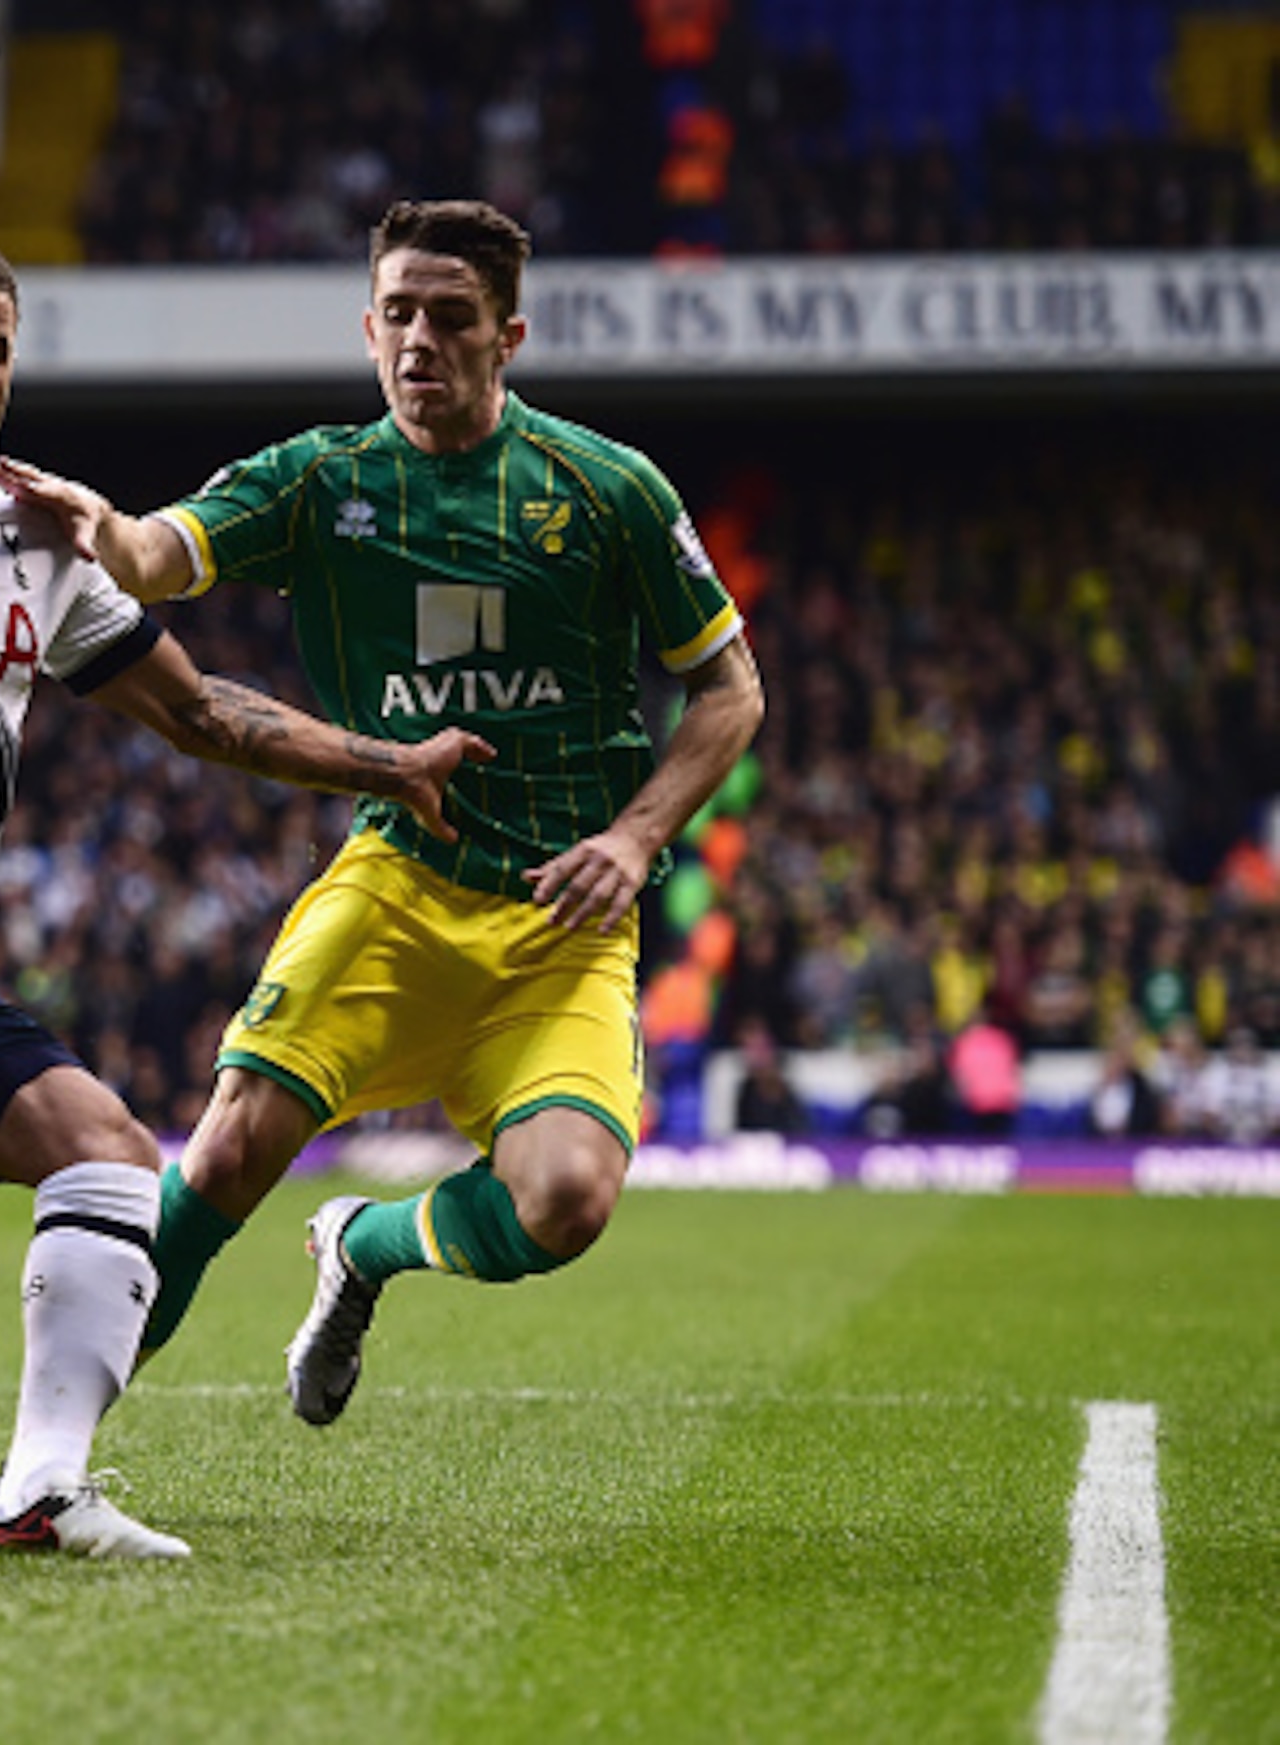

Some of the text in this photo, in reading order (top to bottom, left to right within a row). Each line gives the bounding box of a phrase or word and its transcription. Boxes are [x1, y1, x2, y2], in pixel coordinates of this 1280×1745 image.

[650, 284, 732, 346] IS
[751, 282, 862, 345] MY
[1150, 278, 1270, 343] MY
[380, 668, 564, 719] AVIVA
